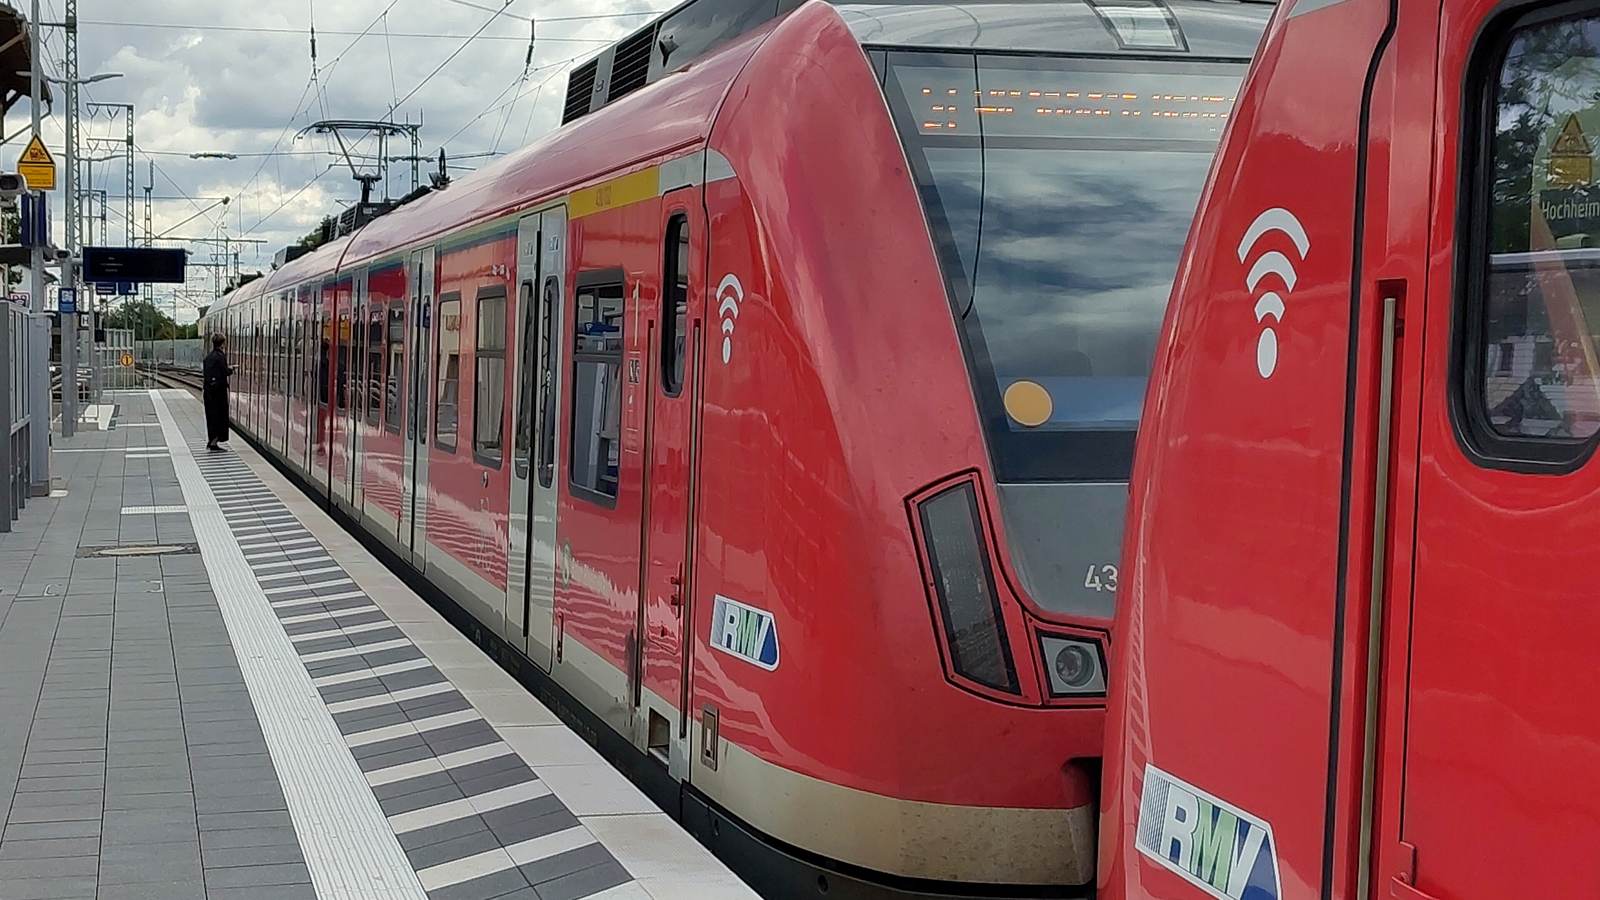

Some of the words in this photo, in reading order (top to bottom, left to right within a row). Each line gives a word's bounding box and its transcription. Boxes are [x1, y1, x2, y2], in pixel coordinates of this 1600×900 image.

[1541, 197, 1600, 220] Hochheim
[1085, 564, 1118, 592] 43
[721, 603, 771, 660] RMV
[1159, 783, 1266, 900] RMV
